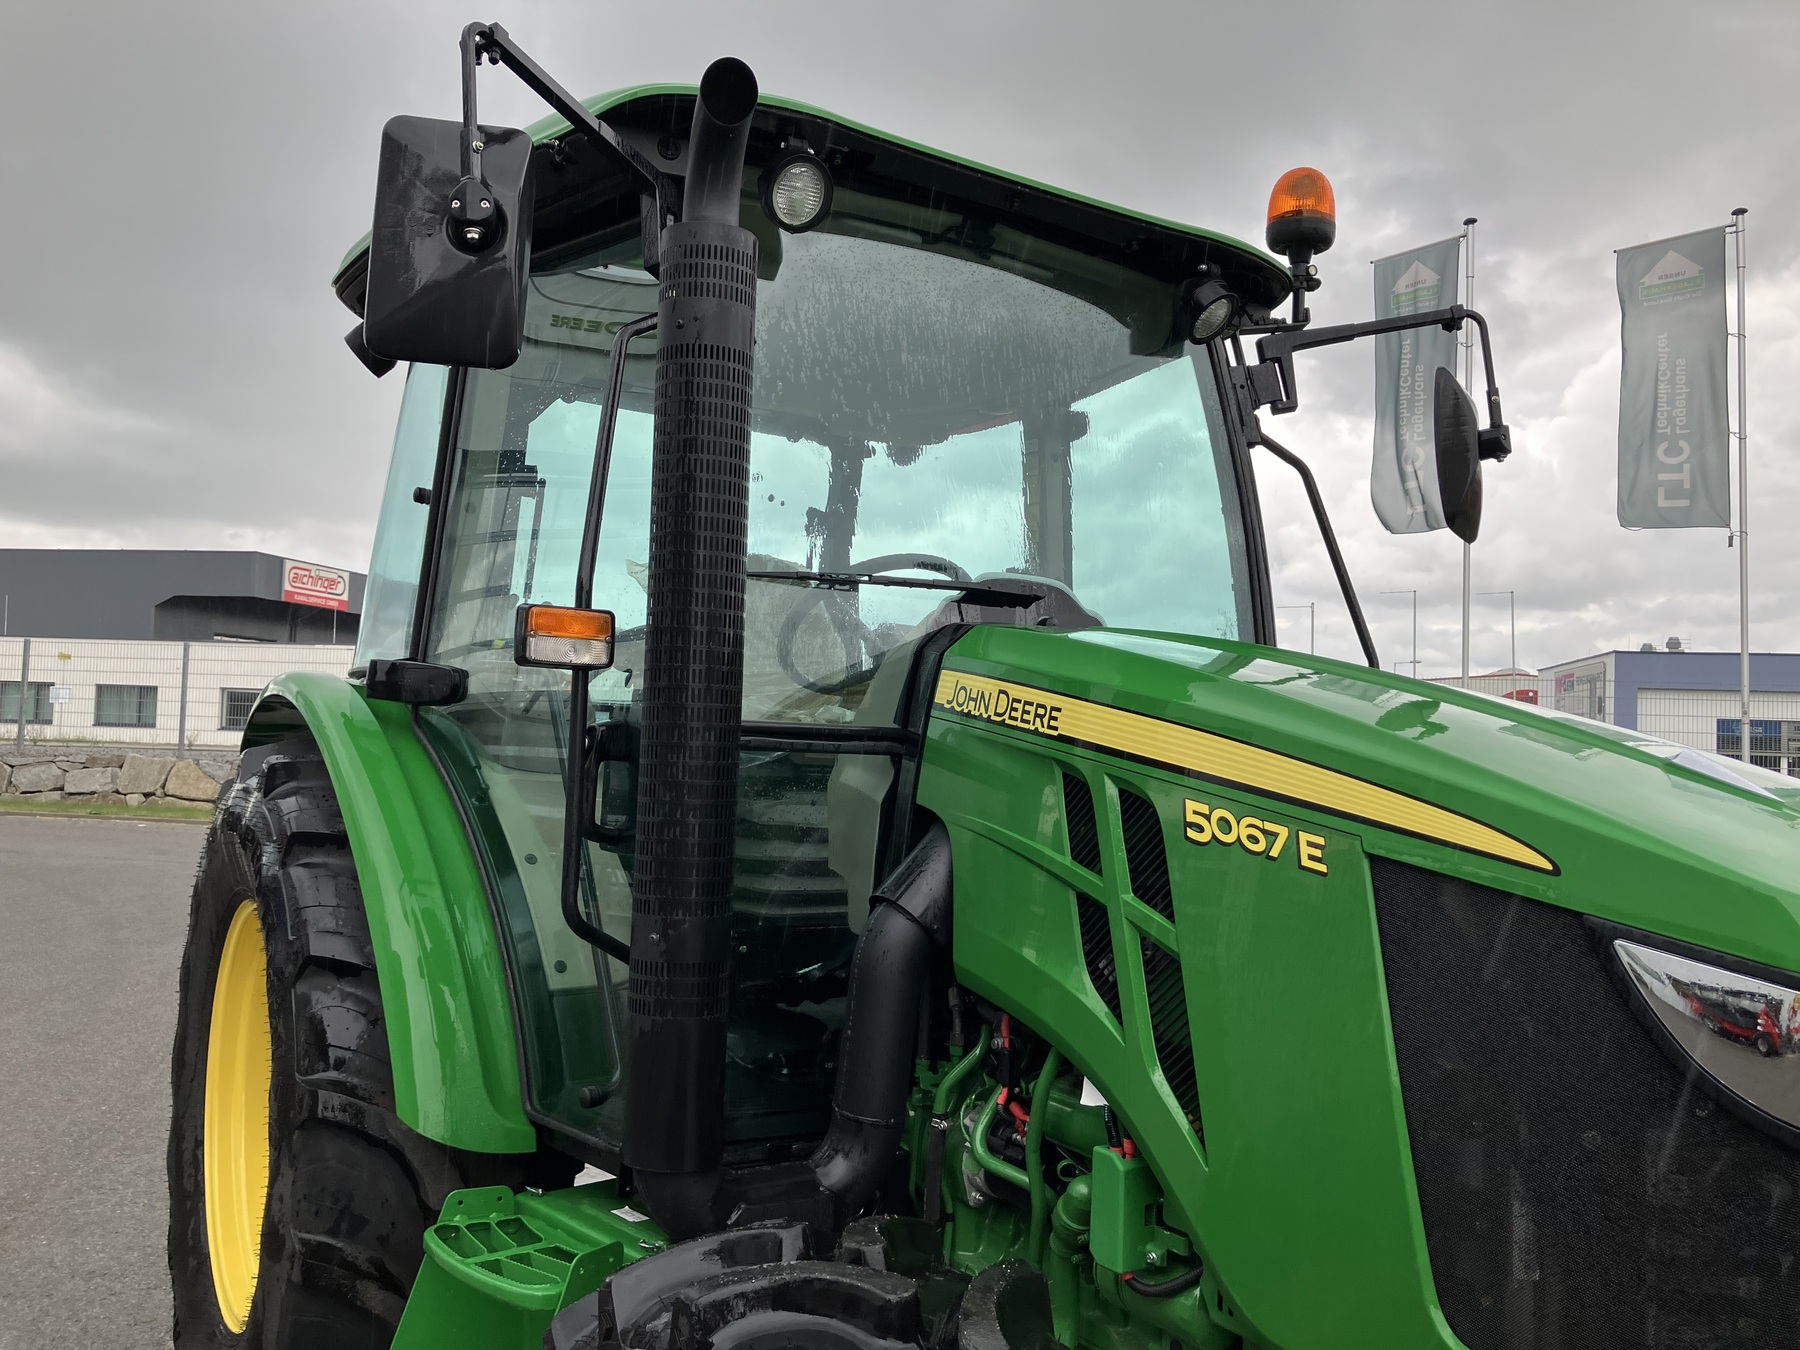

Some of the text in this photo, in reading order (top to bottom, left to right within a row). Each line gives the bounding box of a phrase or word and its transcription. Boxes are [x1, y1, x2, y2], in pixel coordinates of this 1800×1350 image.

[291, 571, 341, 592] aichinger
[945, 679, 1063, 733] JOHN DEERE
[1184, 798, 1328, 877] 5067 E
